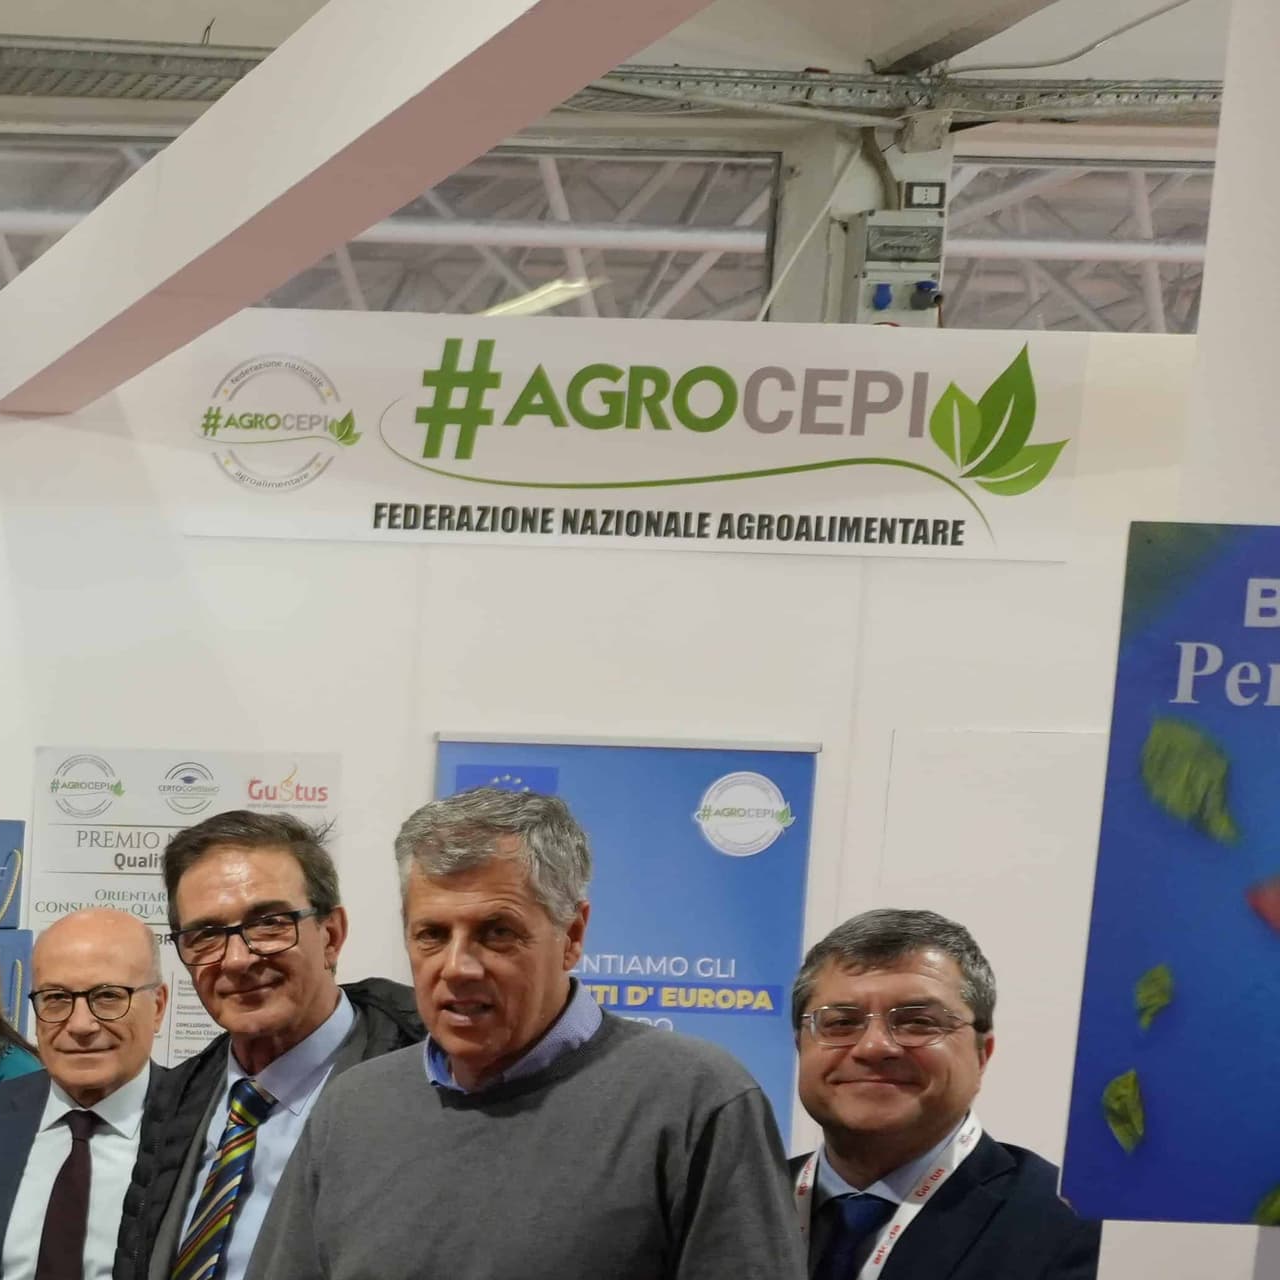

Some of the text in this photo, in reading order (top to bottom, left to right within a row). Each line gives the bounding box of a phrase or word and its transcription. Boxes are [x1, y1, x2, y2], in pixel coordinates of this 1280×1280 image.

[231, 359, 283, 385] federazione
[413, 338, 931, 460] #AGROCEPI
[201, 406, 328, 436] #AGROCEPI
[235, 471, 309, 489] agroalimentare
[373, 502, 966, 546] FEDERAZIONE NAZIONALE AGROALIMENTARE
[76, 830, 160, 849] PREMIO
[131, 903, 169, 918] QUA
[696, 957, 736, 978] GLI
[628, 985, 653, 1006] D'
[661, 987, 773, 1010] EUROPA
